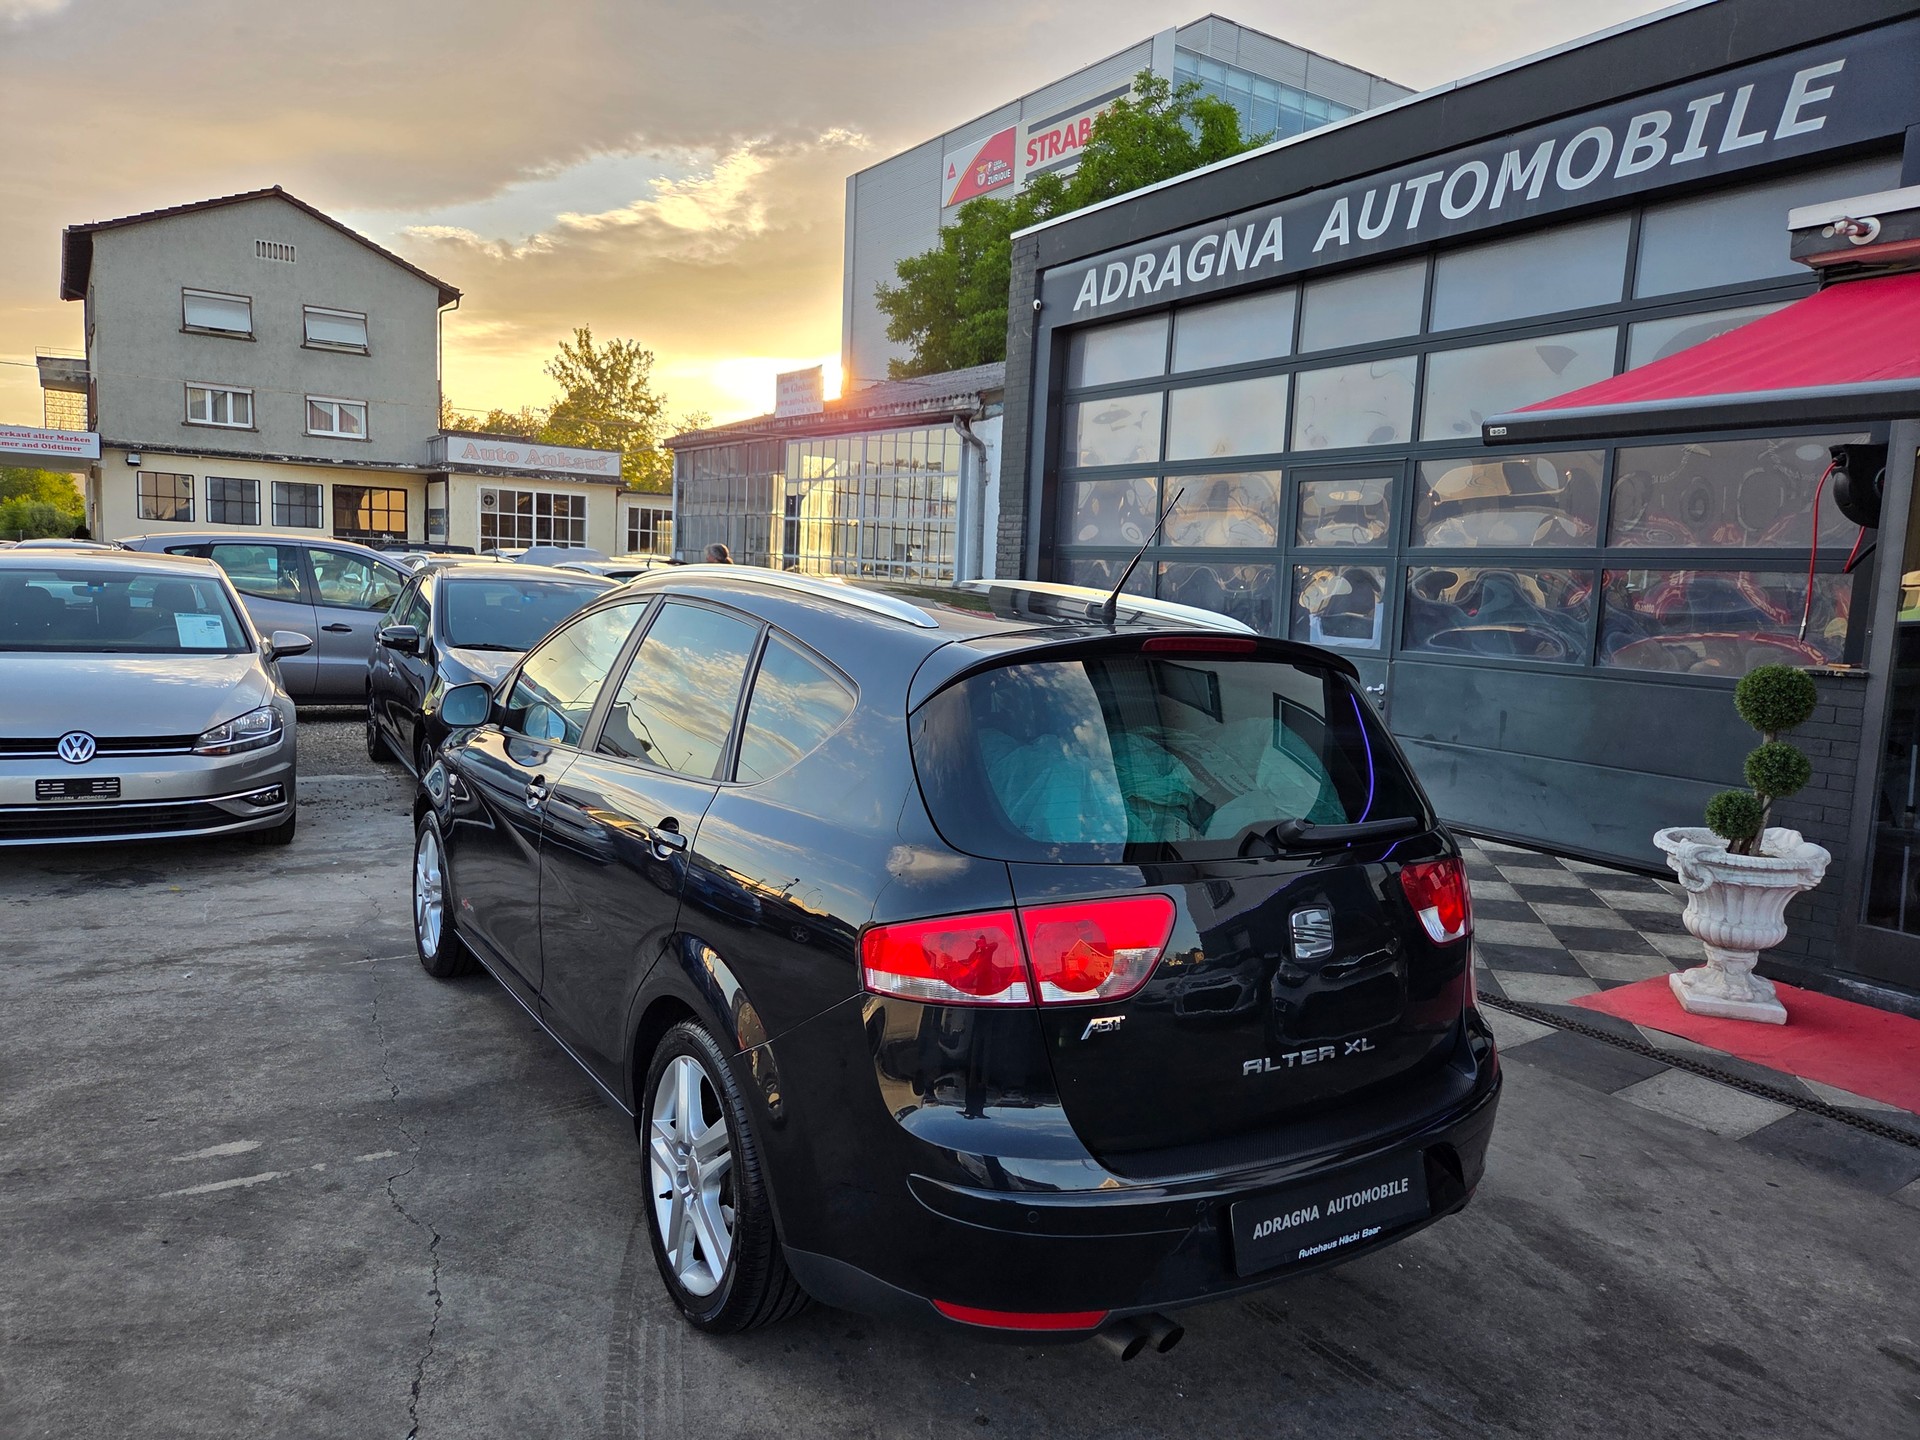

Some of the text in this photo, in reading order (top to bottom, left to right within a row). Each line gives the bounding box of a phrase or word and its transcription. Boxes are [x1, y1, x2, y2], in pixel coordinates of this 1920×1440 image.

[1026, 110, 1108, 167] STRAB
[987, 169, 1011, 185] ZURIQUE
[1073, 58, 1846, 311] ADRAGNA AUTOMOBILE
[41, 443, 82, 452] Oldtimer
[57, 434, 91, 443] Marken
[461, 442, 608, 471] Auto Ankauf
[1081, 1015, 1126, 1041] ABT
[1242, 1037, 1376, 1076] ALTEA XL
[1252, 1177, 1409, 1240] ADRAGNA AUTOMOBILE
[1298, 1240, 1338, 1259] Autohaus
[1361, 1226, 1382, 1238] Baar
